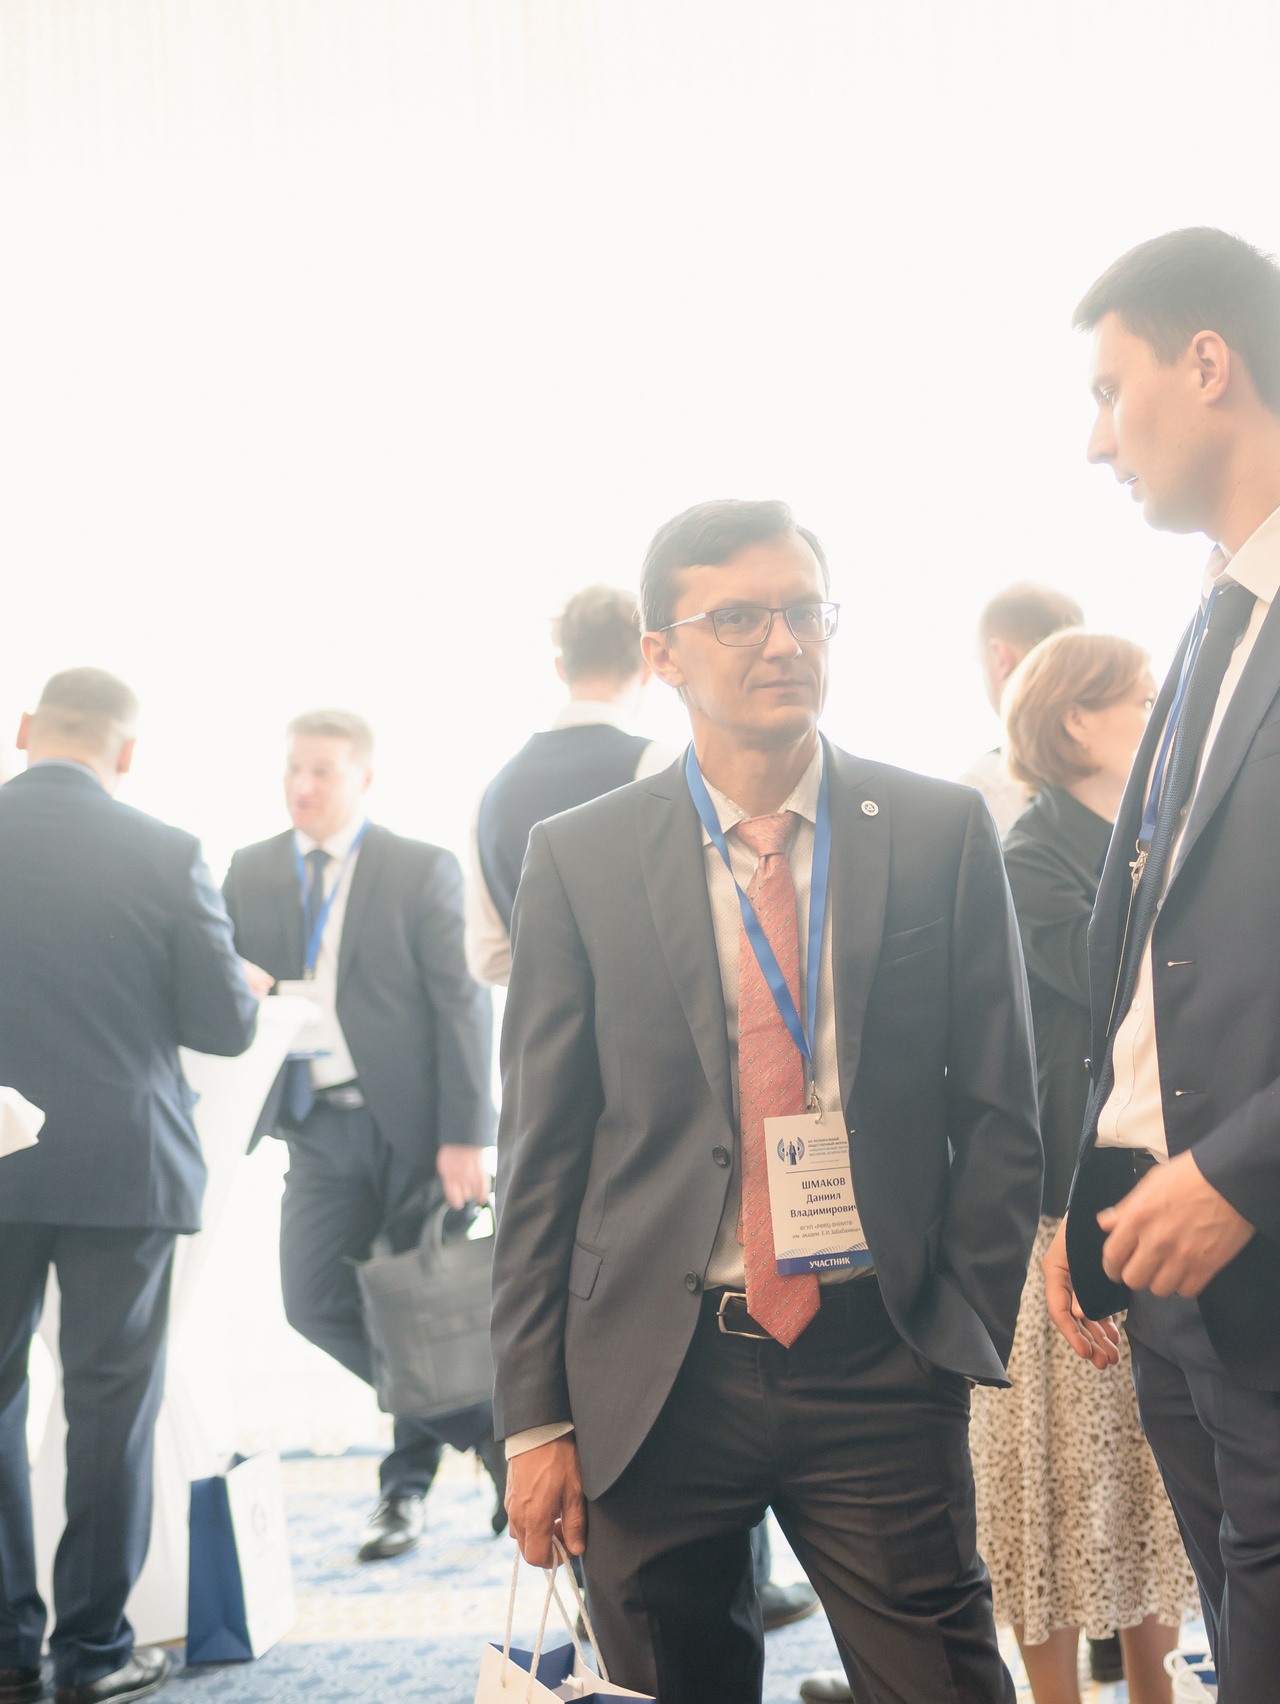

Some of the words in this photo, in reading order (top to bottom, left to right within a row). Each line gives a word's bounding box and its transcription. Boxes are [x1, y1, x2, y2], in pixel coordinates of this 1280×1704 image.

[801, 1177, 846, 1190] ШМАКОВ
[806, 1192, 841, 1204] Даниил
[809, 1257, 850, 1268] УЧАСТНИК
